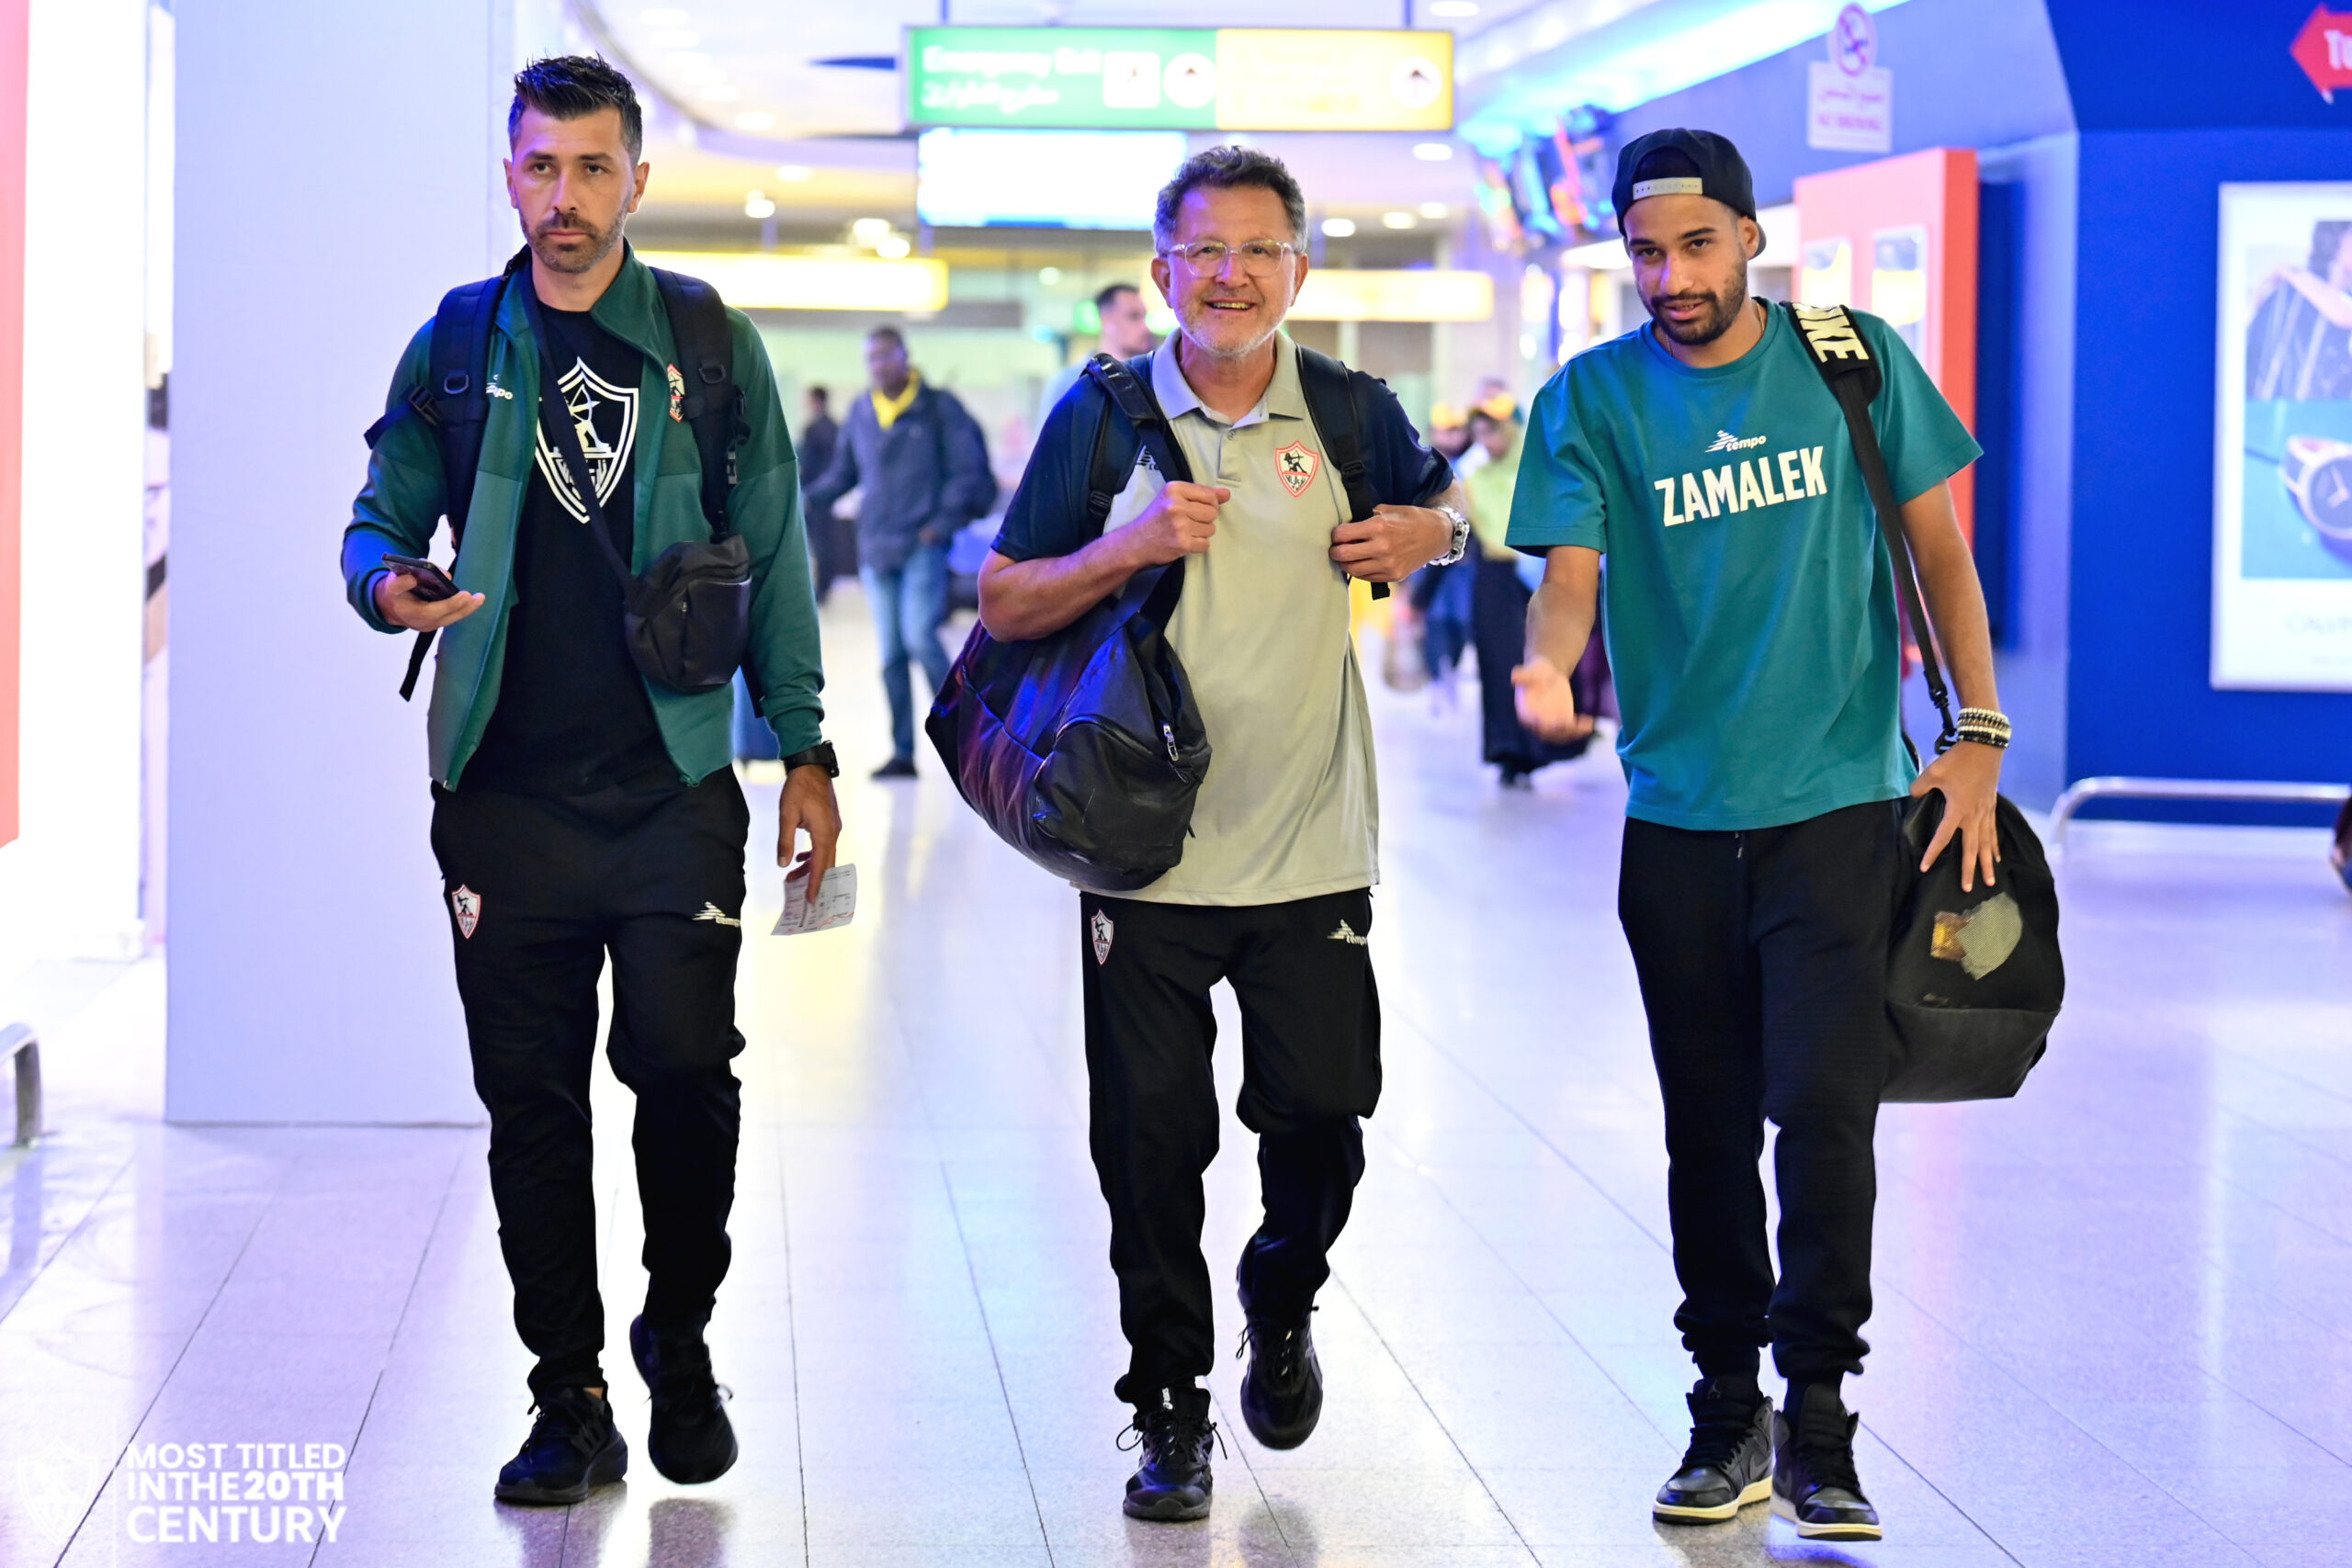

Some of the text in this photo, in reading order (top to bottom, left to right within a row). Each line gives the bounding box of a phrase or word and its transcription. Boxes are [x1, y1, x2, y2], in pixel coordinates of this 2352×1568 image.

[1792, 304, 1869, 364] IKE
[1726, 435, 1767, 451] tempo
[1654, 446, 1827, 527] ZAMALEK
[1346, 934, 1367, 946] temp
